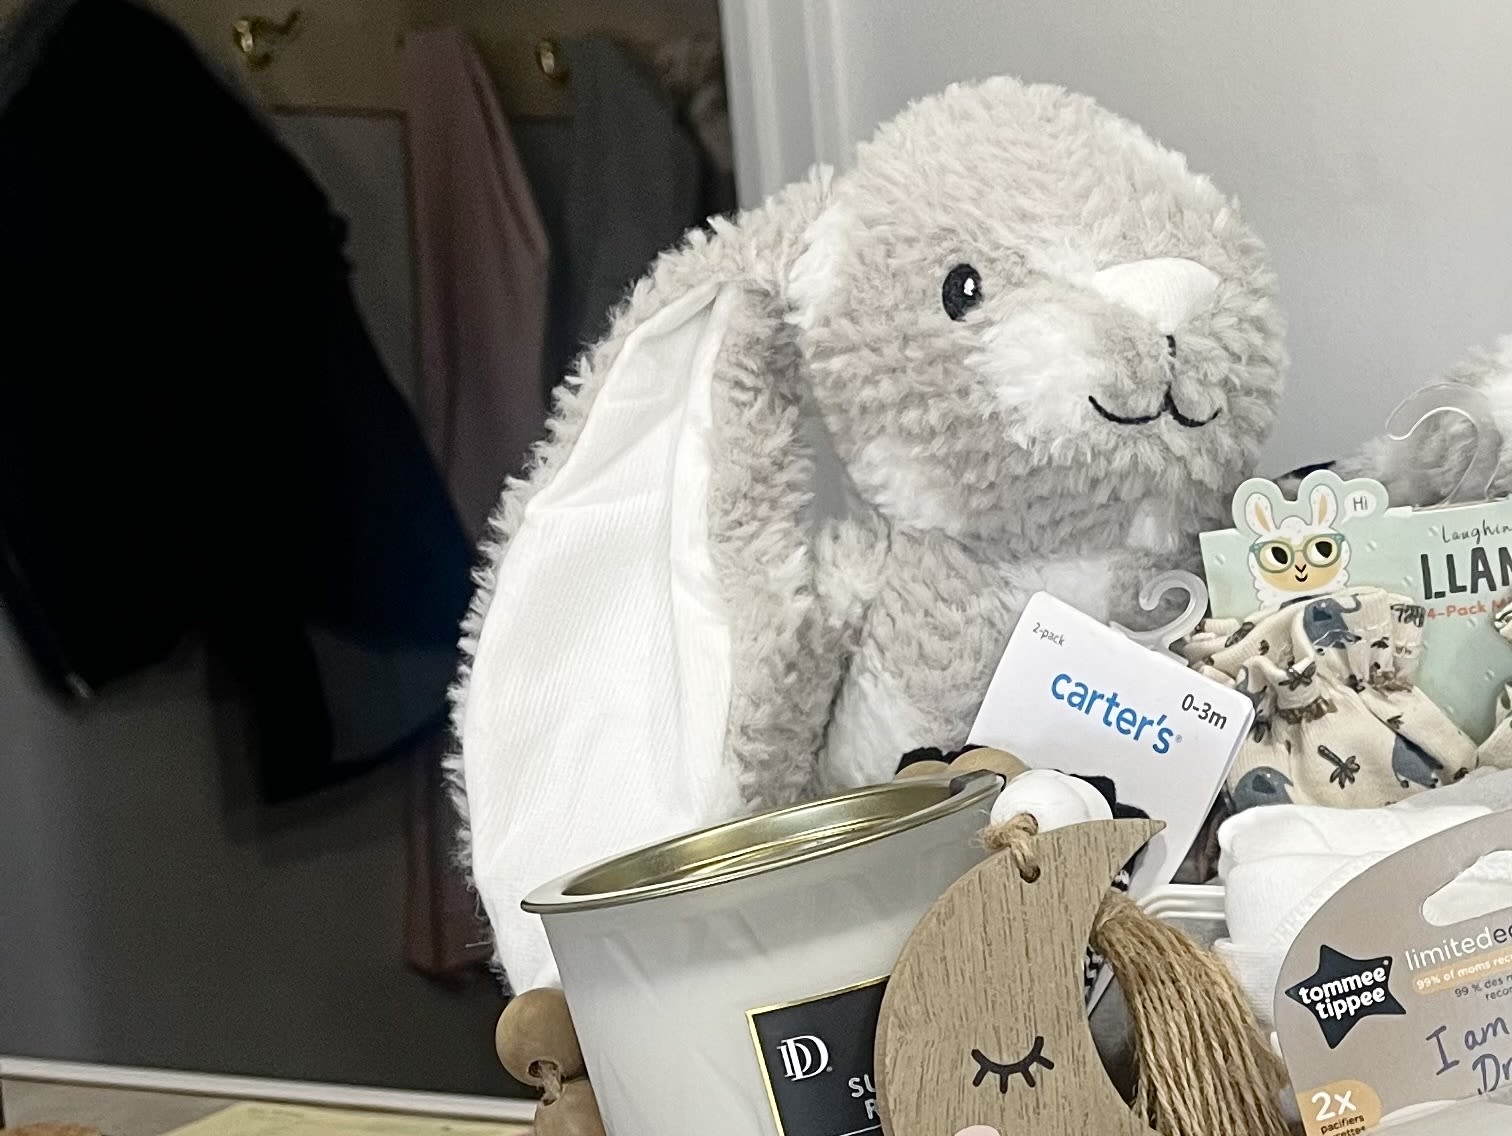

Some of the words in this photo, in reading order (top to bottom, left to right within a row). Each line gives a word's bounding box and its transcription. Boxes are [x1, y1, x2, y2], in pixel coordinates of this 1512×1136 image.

[1352, 496, 1369, 512] Hi
[1427, 601, 1487, 621] 4-Pack
[1031, 621, 1067, 647] 2-pack
[1050, 672, 1175, 755] carter's
[1180, 693, 1229, 731] 0-3m
[1298, 966, 1387, 1006] tommee
[1415, 973, 1441, 991] 99%
[1443, 967, 1455, 981] of
[1457, 960, 1491, 977] moms
[1484, 977, 1504, 990] des
[1315, 987, 1387, 1021] tippee
[1425, 1025, 1460, 1076] I
[1463, 1016, 1510, 1051] am
[1311, 1089, 1357, 1121] 2x
[1320, 1114, 1366, 1136] pacifiers
